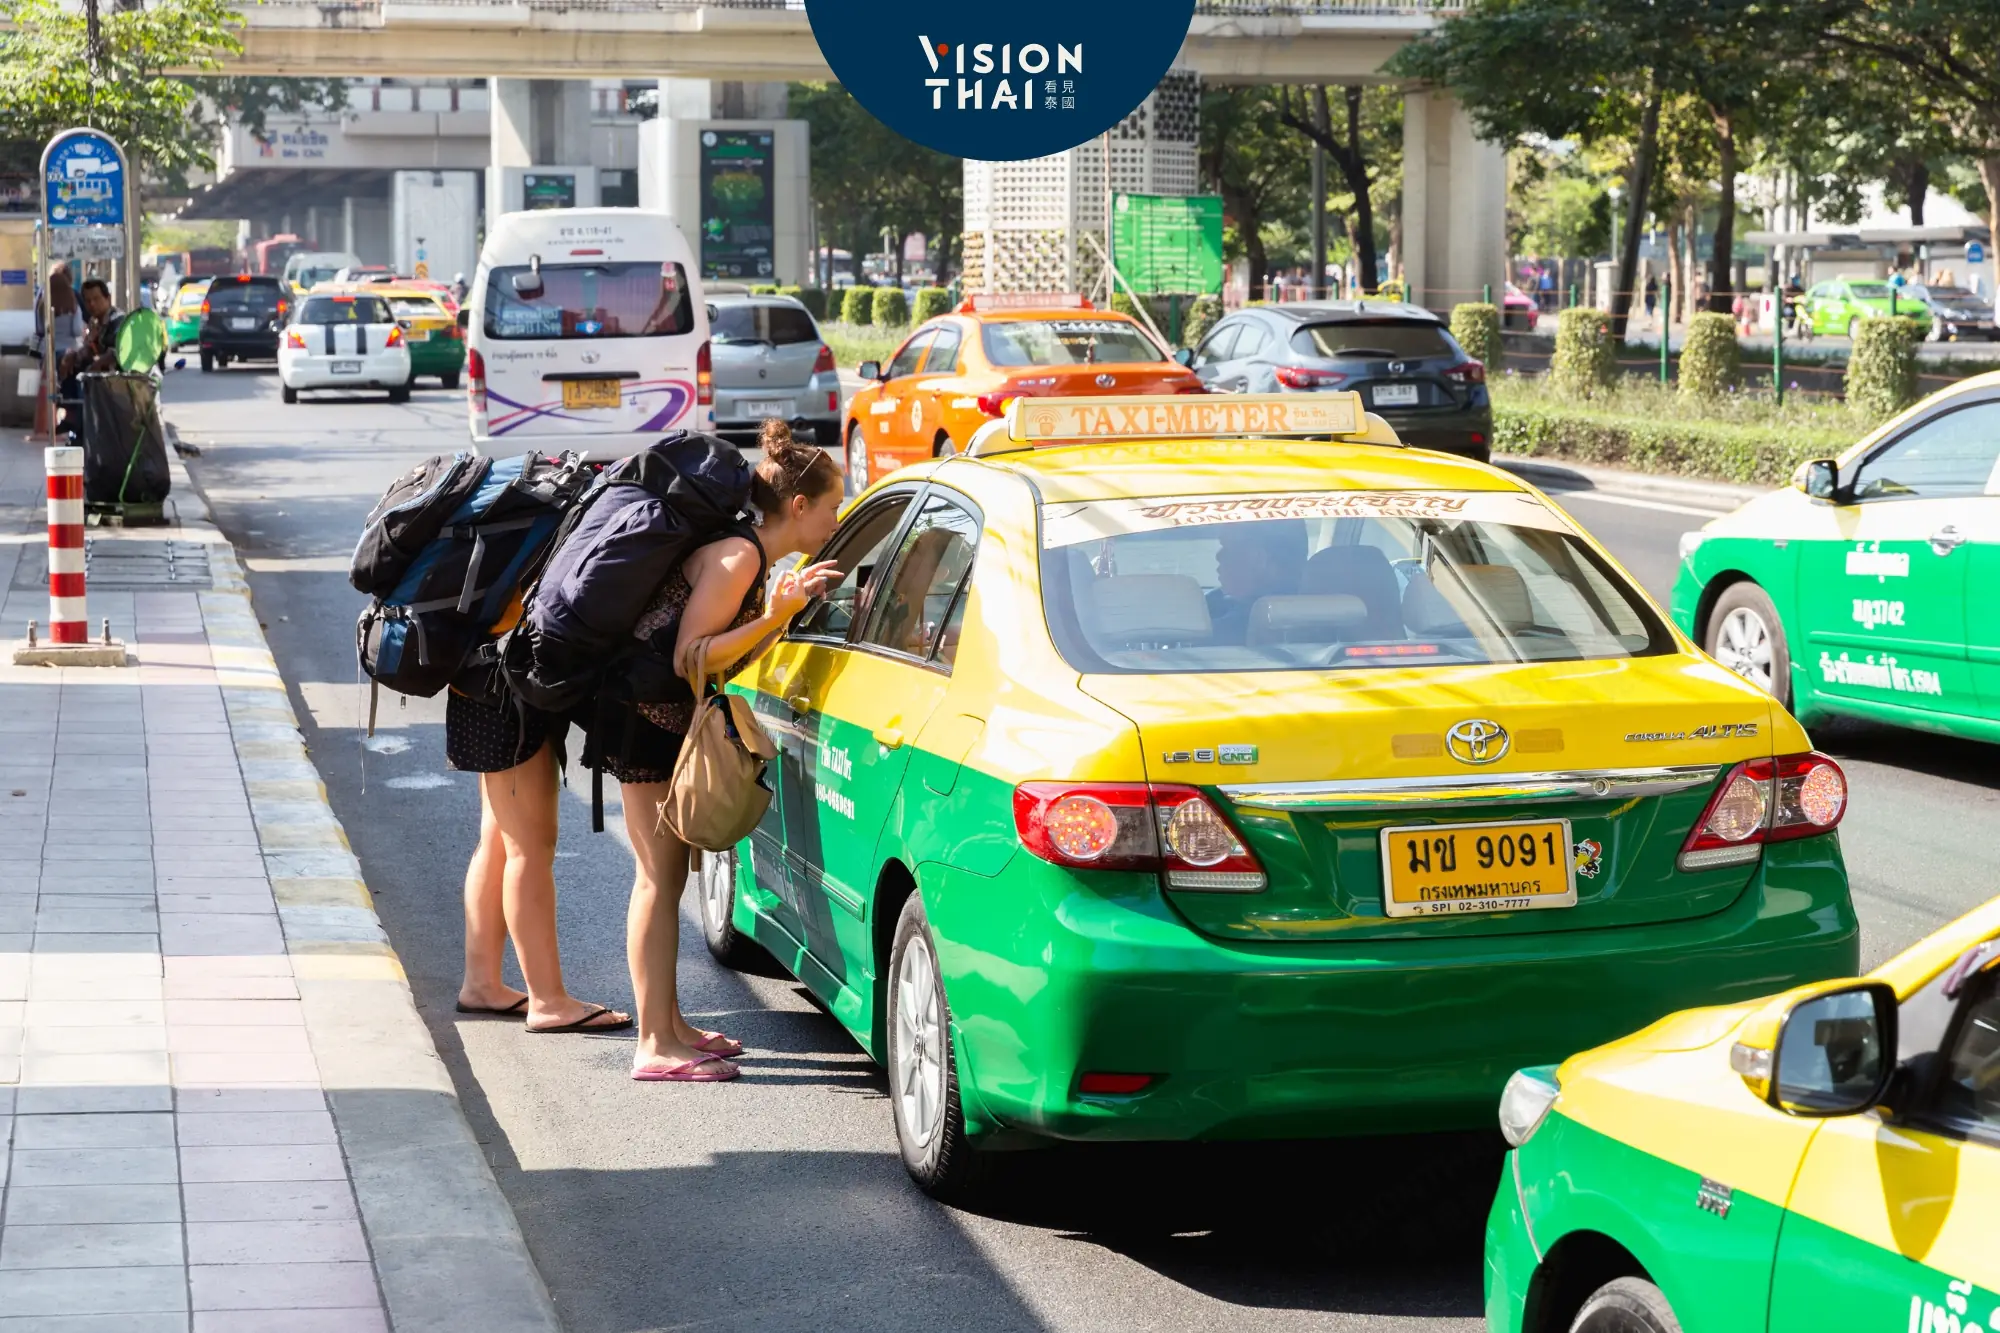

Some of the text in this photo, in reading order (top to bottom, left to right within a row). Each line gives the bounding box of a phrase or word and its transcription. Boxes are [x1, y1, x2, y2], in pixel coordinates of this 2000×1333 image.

[1071, 403, 1291, 436] TAXI-METER
[1173, 507, 1440, 526] LONG LIVE THE KING
[1624, 723, 1758, 742] COROLLA ALTIS
[1221, 753, 1252, 762] CNG
[1475, 832, 1556, 869] 9091
[1419, 880, 1541, 900] กรงเทพมหานคร
[1431, 898, 1531, 912] SPI 02-310-7777
